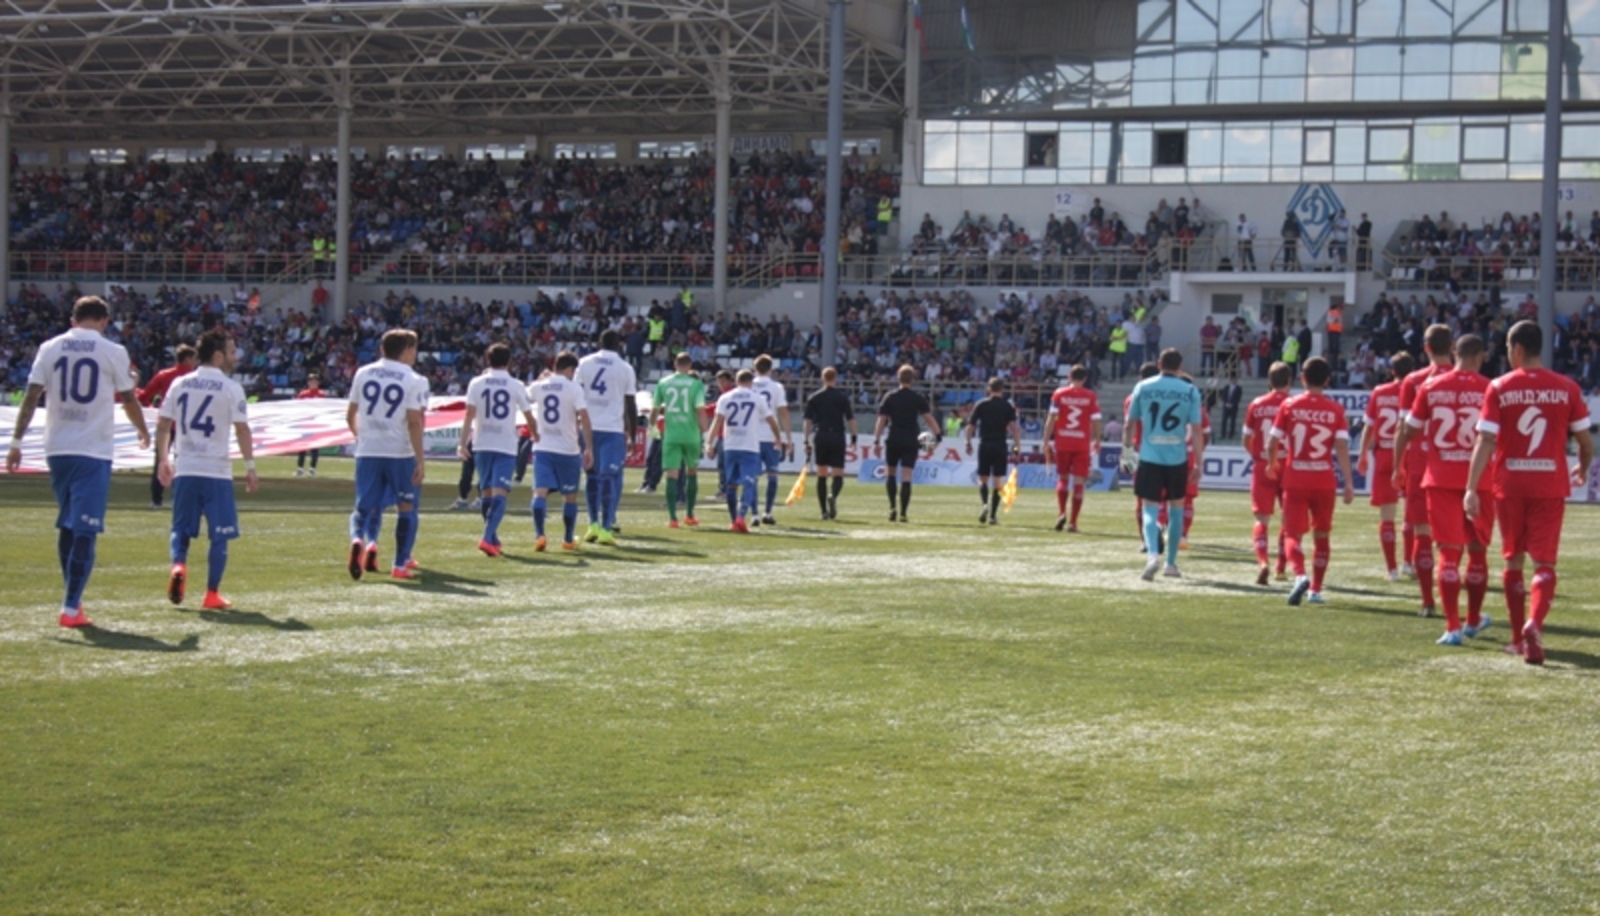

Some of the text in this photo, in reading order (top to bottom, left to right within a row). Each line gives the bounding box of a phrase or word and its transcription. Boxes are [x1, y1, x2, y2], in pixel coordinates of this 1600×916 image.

[1056, 193, 1071, 204] 12
[1558, 188, 1574, 200] 13
[54, 356, 99, 404] 10
[590, 368, 607, 395] 4
[177, 393, 215, 437] 14
[363, 381, 404, 418] 99
[481, 388, 510, 420] 18
[543, 394, 560, 424] 8
[665, 387, 690, 413] 21
[726, 402, 755, 426] 27
[1066, 405, 1082, 429] 3
[1149, 401, 1181, 432] 16
[1432, 406, 1482, 449] 28
[1517, 405, 1547, 457] 9
[1292, 423, 1332, 459] 13
